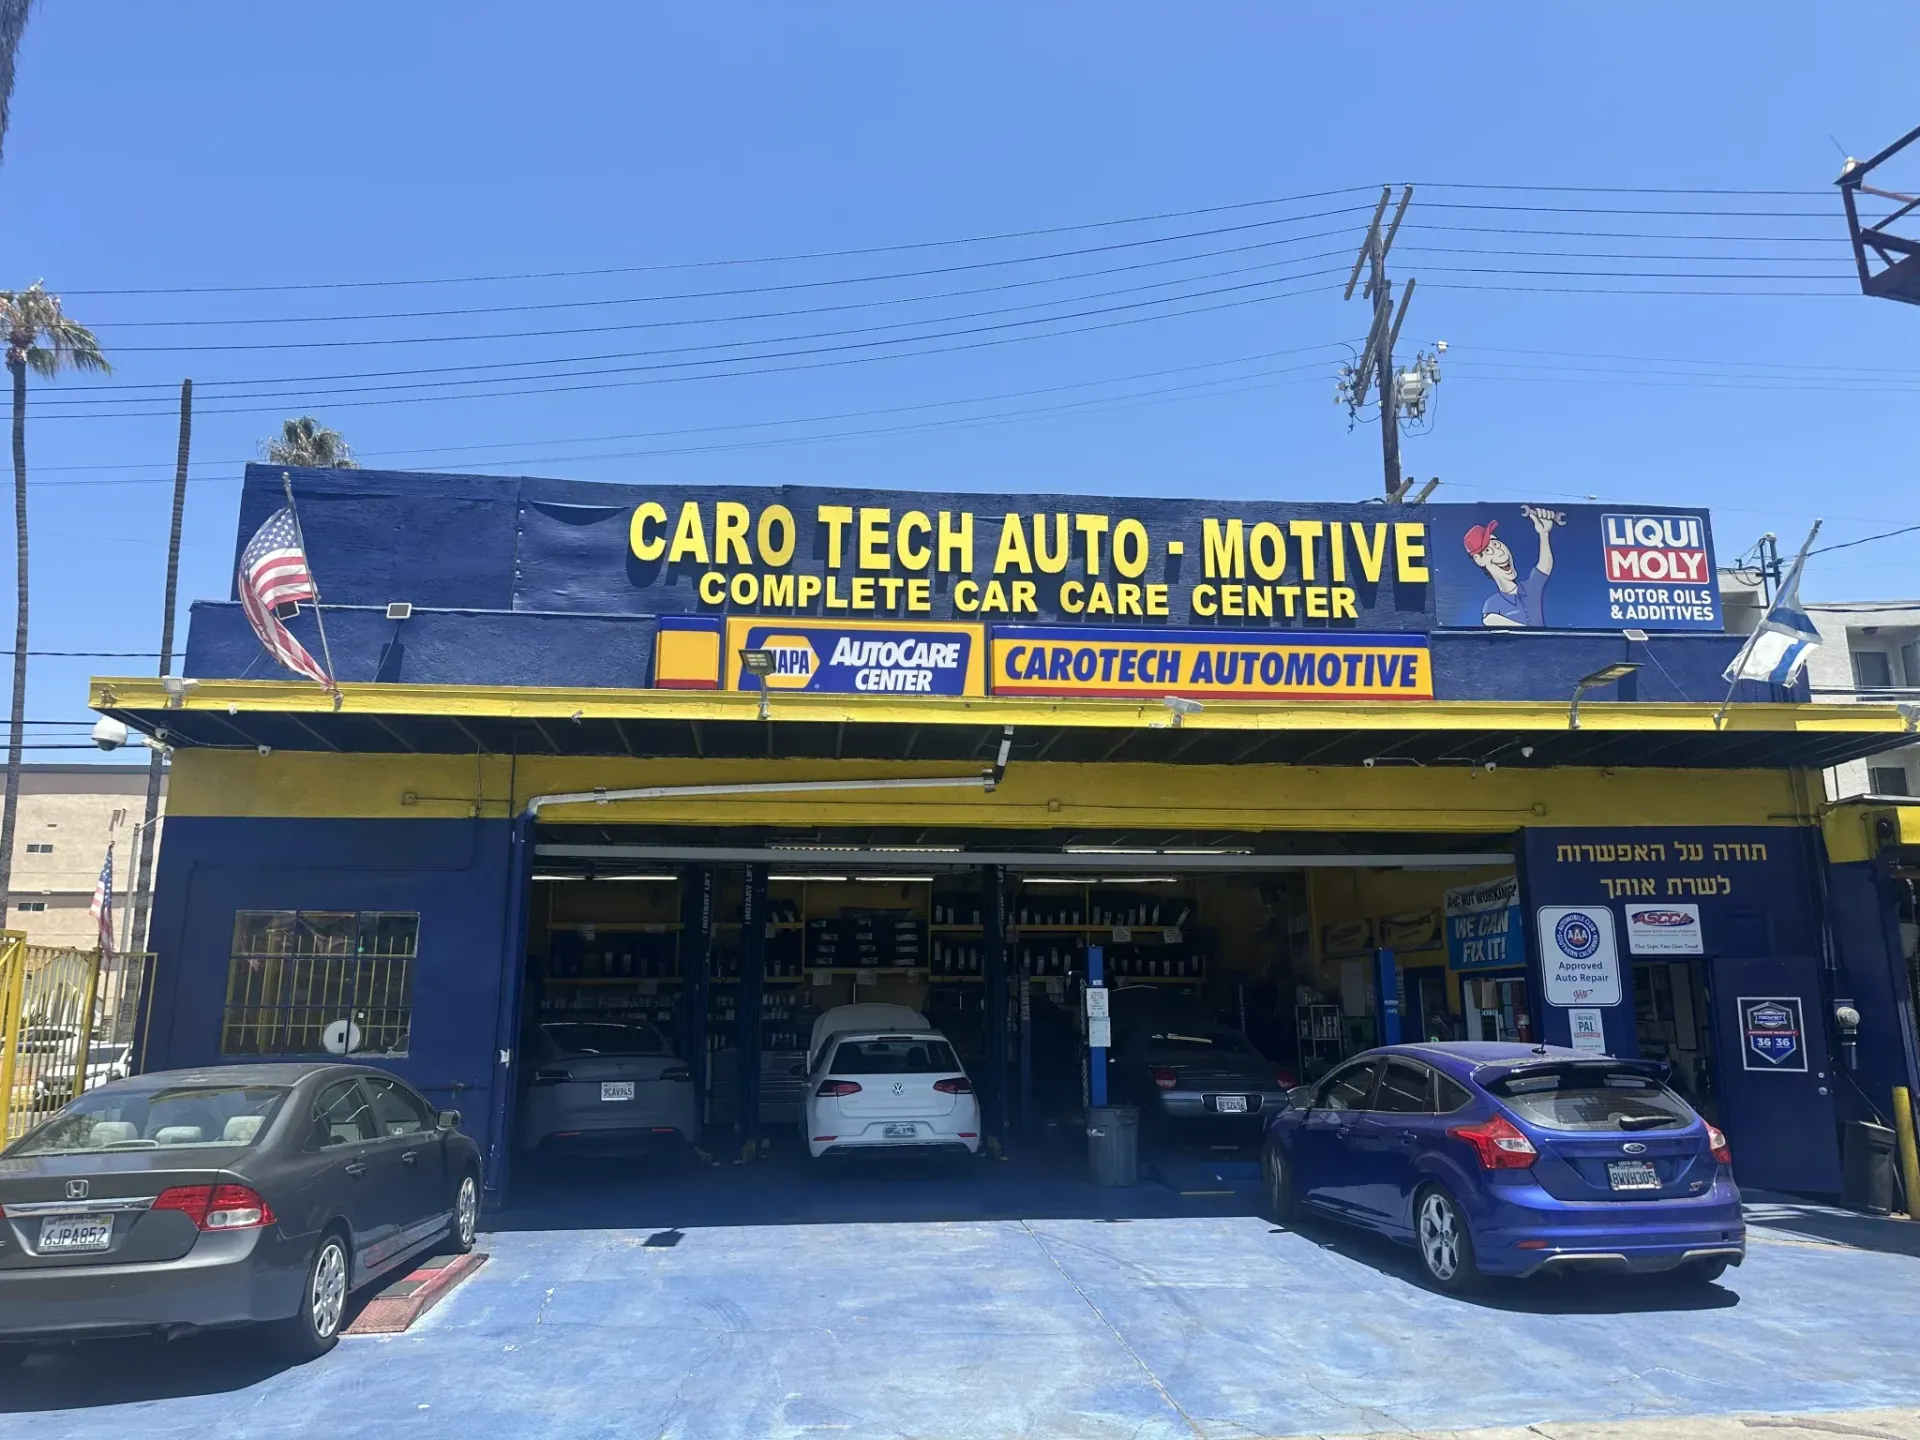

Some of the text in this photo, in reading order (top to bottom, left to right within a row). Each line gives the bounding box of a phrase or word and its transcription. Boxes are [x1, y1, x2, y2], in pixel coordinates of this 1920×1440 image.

[1608, 518, 1699, 546] LIQUI
[630, 502, 796, 567] CARO
[818, 506, 974, 573] TECH
[994, 512, 1149, 578] AUTO
[1203, 518, 1430, 584] MOTIVE
[1611, 551, 1704, 580] MOLY
[699, 572, 1359, 619] COMPLETE CAR CARE CENTER
[1609, 588, 1712, 605] MOTOR OILS
[1610, 604, 1715, 622] & ADDITIVES
[1004, 646, 1418, 688] CAROTECH AUTOMOTIVE
[854, 668, 933, 693] CENTER
[1556, 841, 1768, 863] תודה על האפשרות
[1600, 875, 1732, 900] לשרת אותך
[1454, 916, 1476, 940] WE
[1478, 910, 1509, 937] CAN
[1567, 927, 1588, 941] AAA
[1583, 917, 1597, 932] CLUB
[1463, 936, 1507, 964] FIX IT!
[1558, 961, 1603, 971] Approved
[1555, 974, 1609, 984] Auto Repair
[1578, 1021, 1595, 1032] PAL
[1756, 1037, 1791, 1046] 36 36
[1612, 1171, 1656, 1185] 8WVH305
[43, 1227, 107, 1246] 6JPA852
